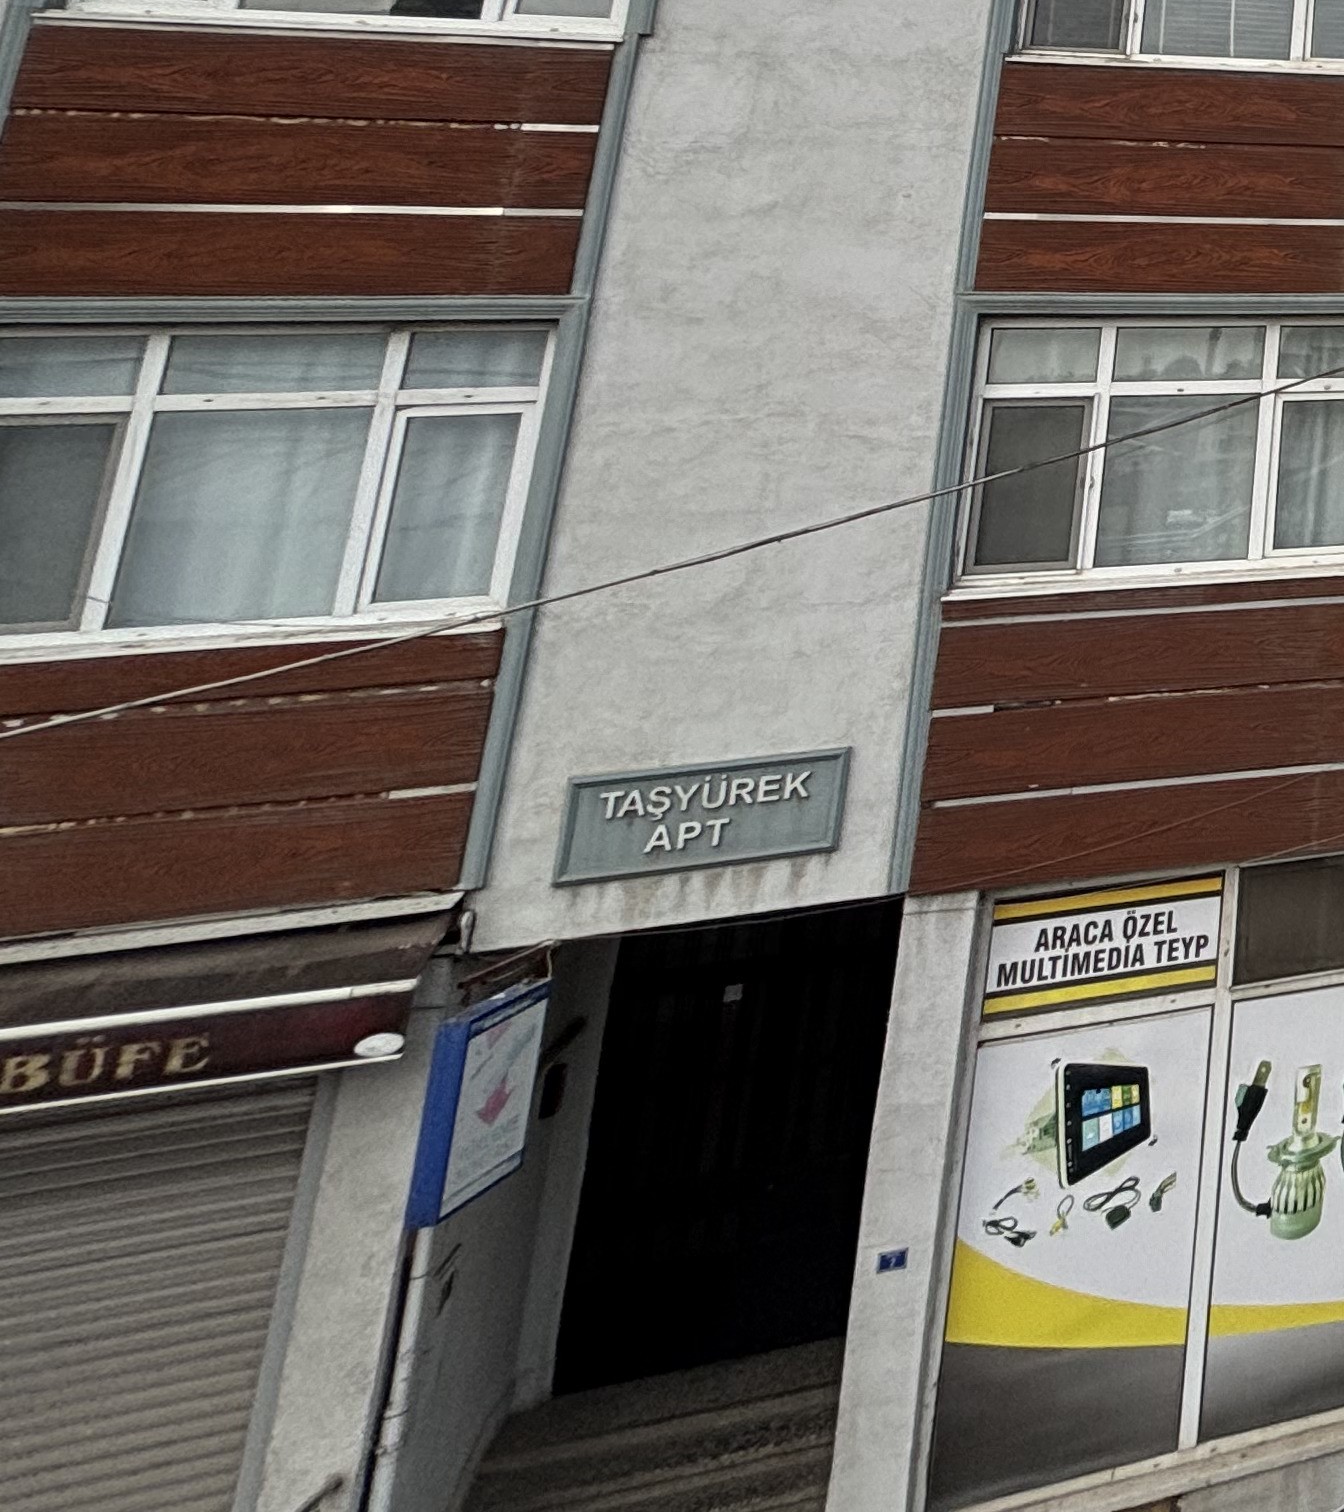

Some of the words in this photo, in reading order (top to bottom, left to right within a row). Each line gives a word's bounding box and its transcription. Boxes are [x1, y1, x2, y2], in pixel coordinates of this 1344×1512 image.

[600, 770, 813, 821] TAŞYÜREK
[643, 817, 731, 854] APT
[1034, 918, 1114, 953] ARACA
[1122, 910, 1178, 941] ÖZEL
[996, 938, 1145, 988] MULTİMEDİA
[1154, 935, 1210, 964] TEYP
[0, 1032, 210, 1094] BÜFE
